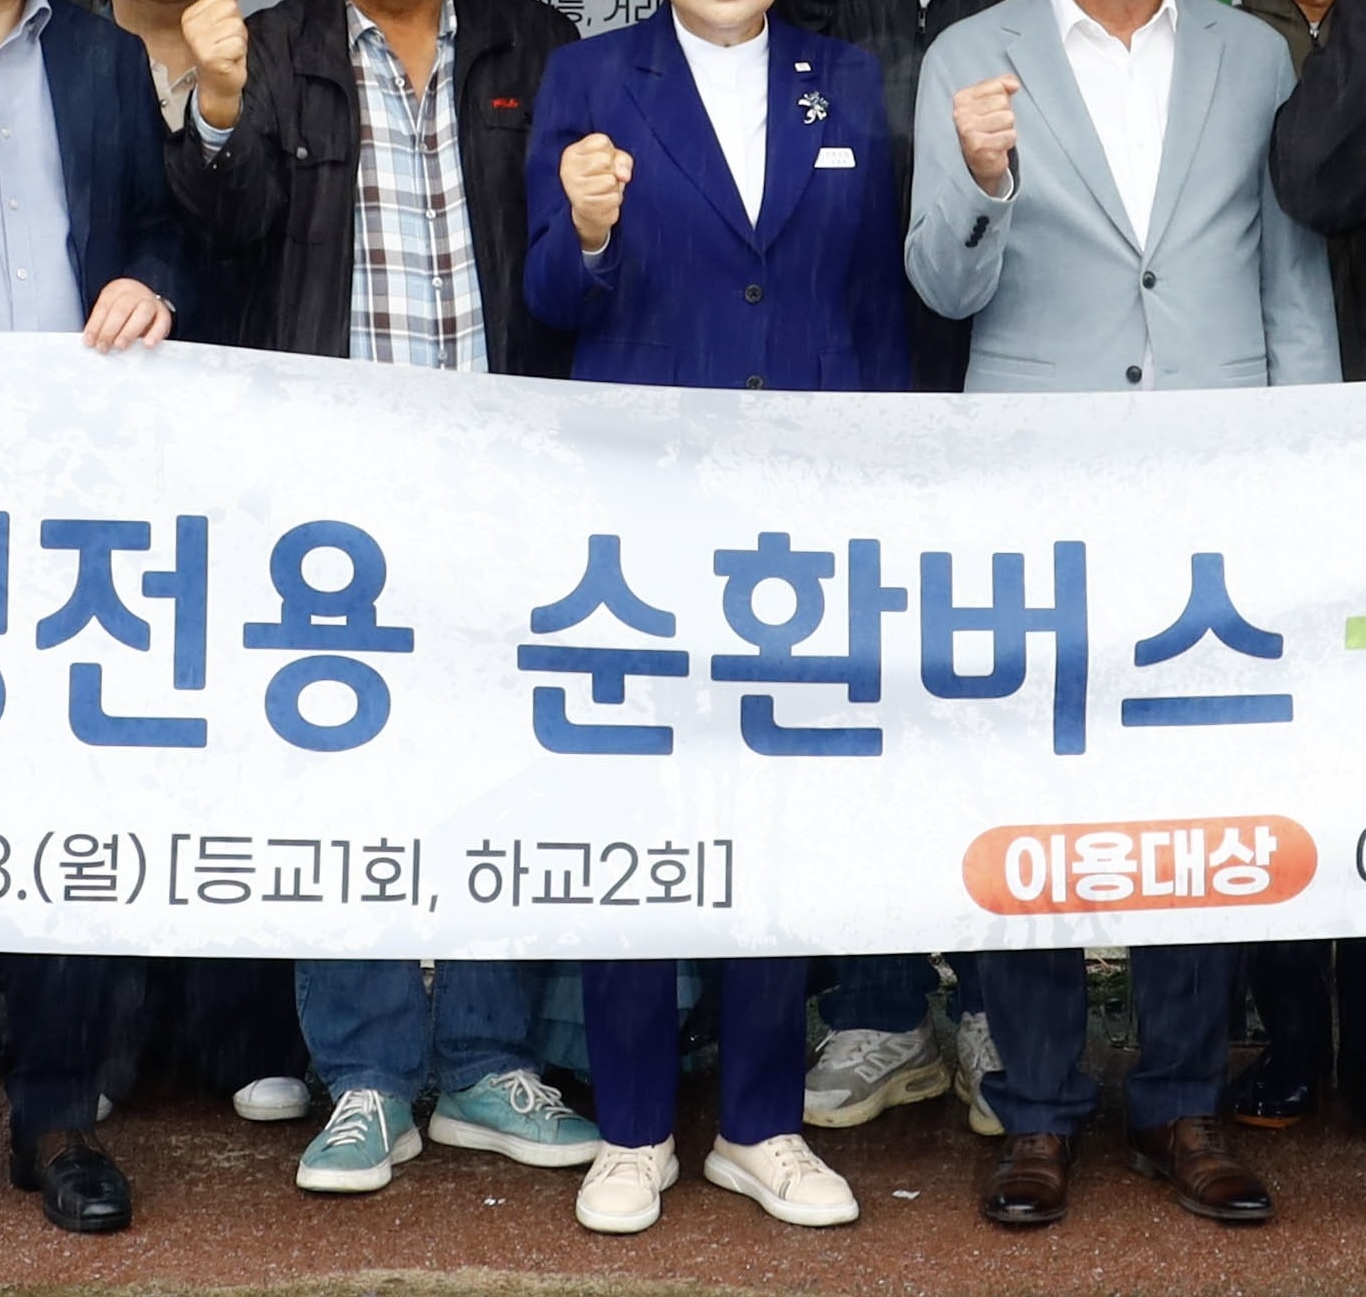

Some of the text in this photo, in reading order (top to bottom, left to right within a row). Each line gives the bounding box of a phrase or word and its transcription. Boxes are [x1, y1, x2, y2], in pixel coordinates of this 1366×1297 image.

[517, 531, 1294, 757] 순환버스
[466, 838, 733, 909] 하교2회]
[1004, 825, 1279, 903] 이용대상
